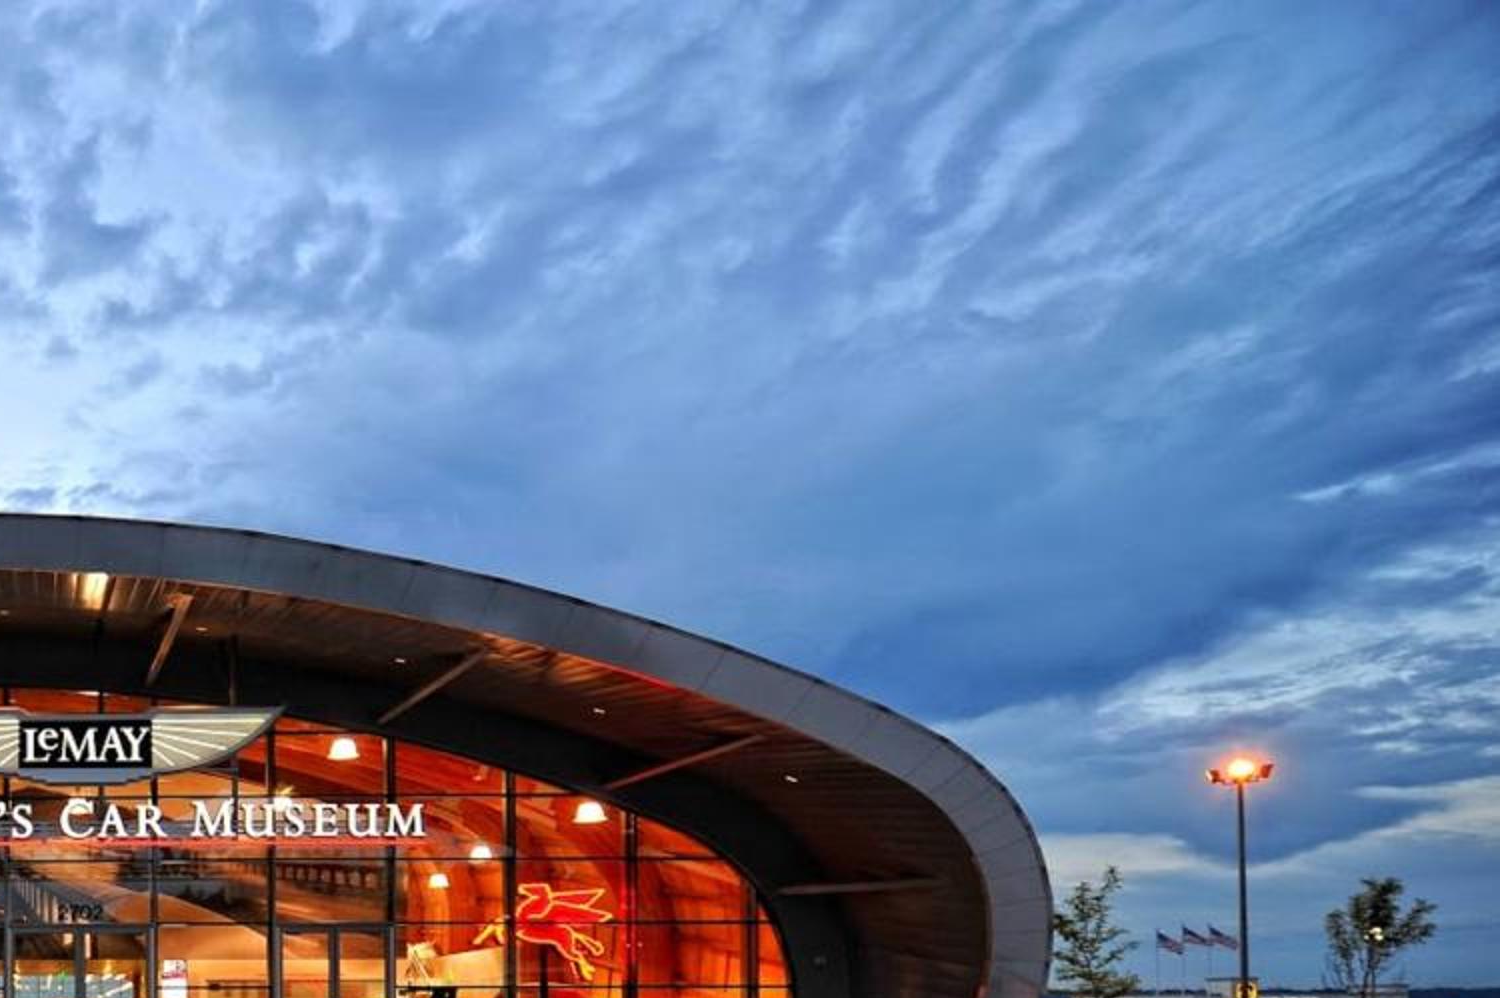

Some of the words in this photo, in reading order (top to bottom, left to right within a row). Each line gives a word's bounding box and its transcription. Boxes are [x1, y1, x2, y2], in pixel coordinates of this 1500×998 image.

[23, 726, 150, 764] LeMAY
[59, 799, 167, 838] CAR
[189, 800, 425, 838] MUSEUM
